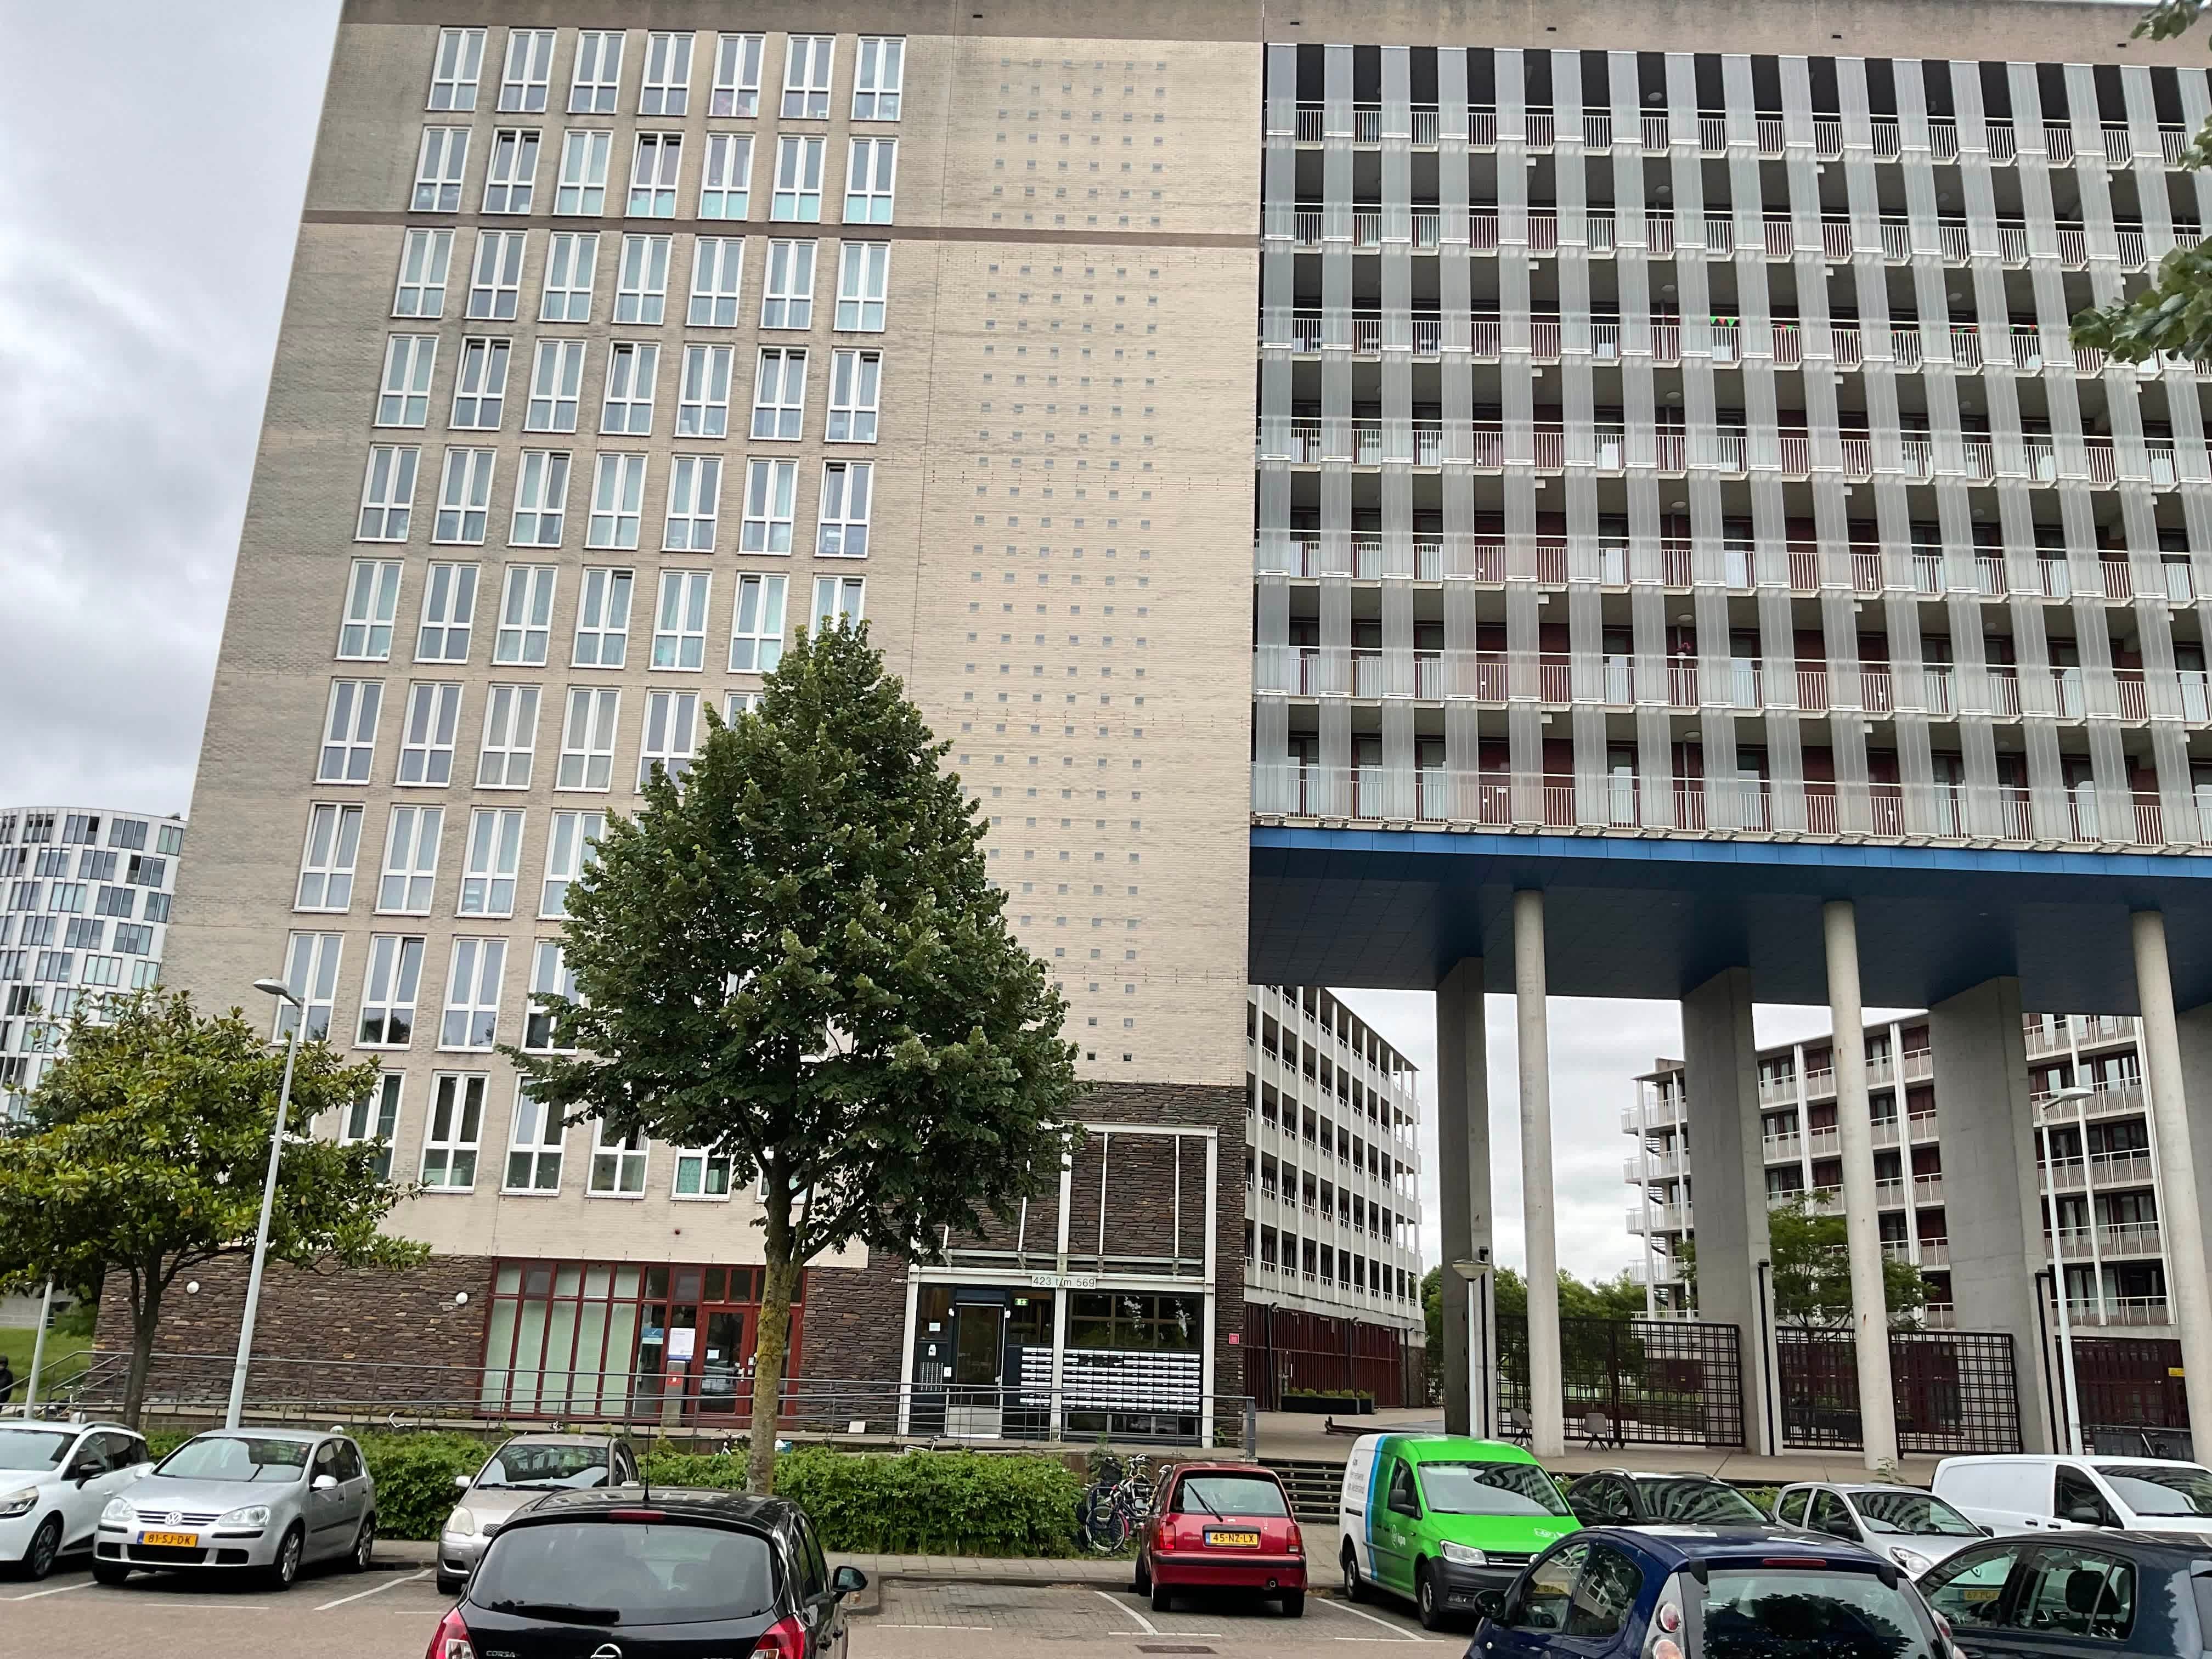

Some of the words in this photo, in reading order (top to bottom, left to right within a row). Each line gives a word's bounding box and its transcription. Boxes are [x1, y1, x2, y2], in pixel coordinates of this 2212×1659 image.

[1033, 1277, 1051, 1286] 423
[1056, 1277, 1071, 1287] t/m
[1076, 1278, 1094, 1287] 569
[148, 1534, 191, 1545] 81-SJ-DK
[1212, 1533, 1255, 1543] 45-NZ-LX
